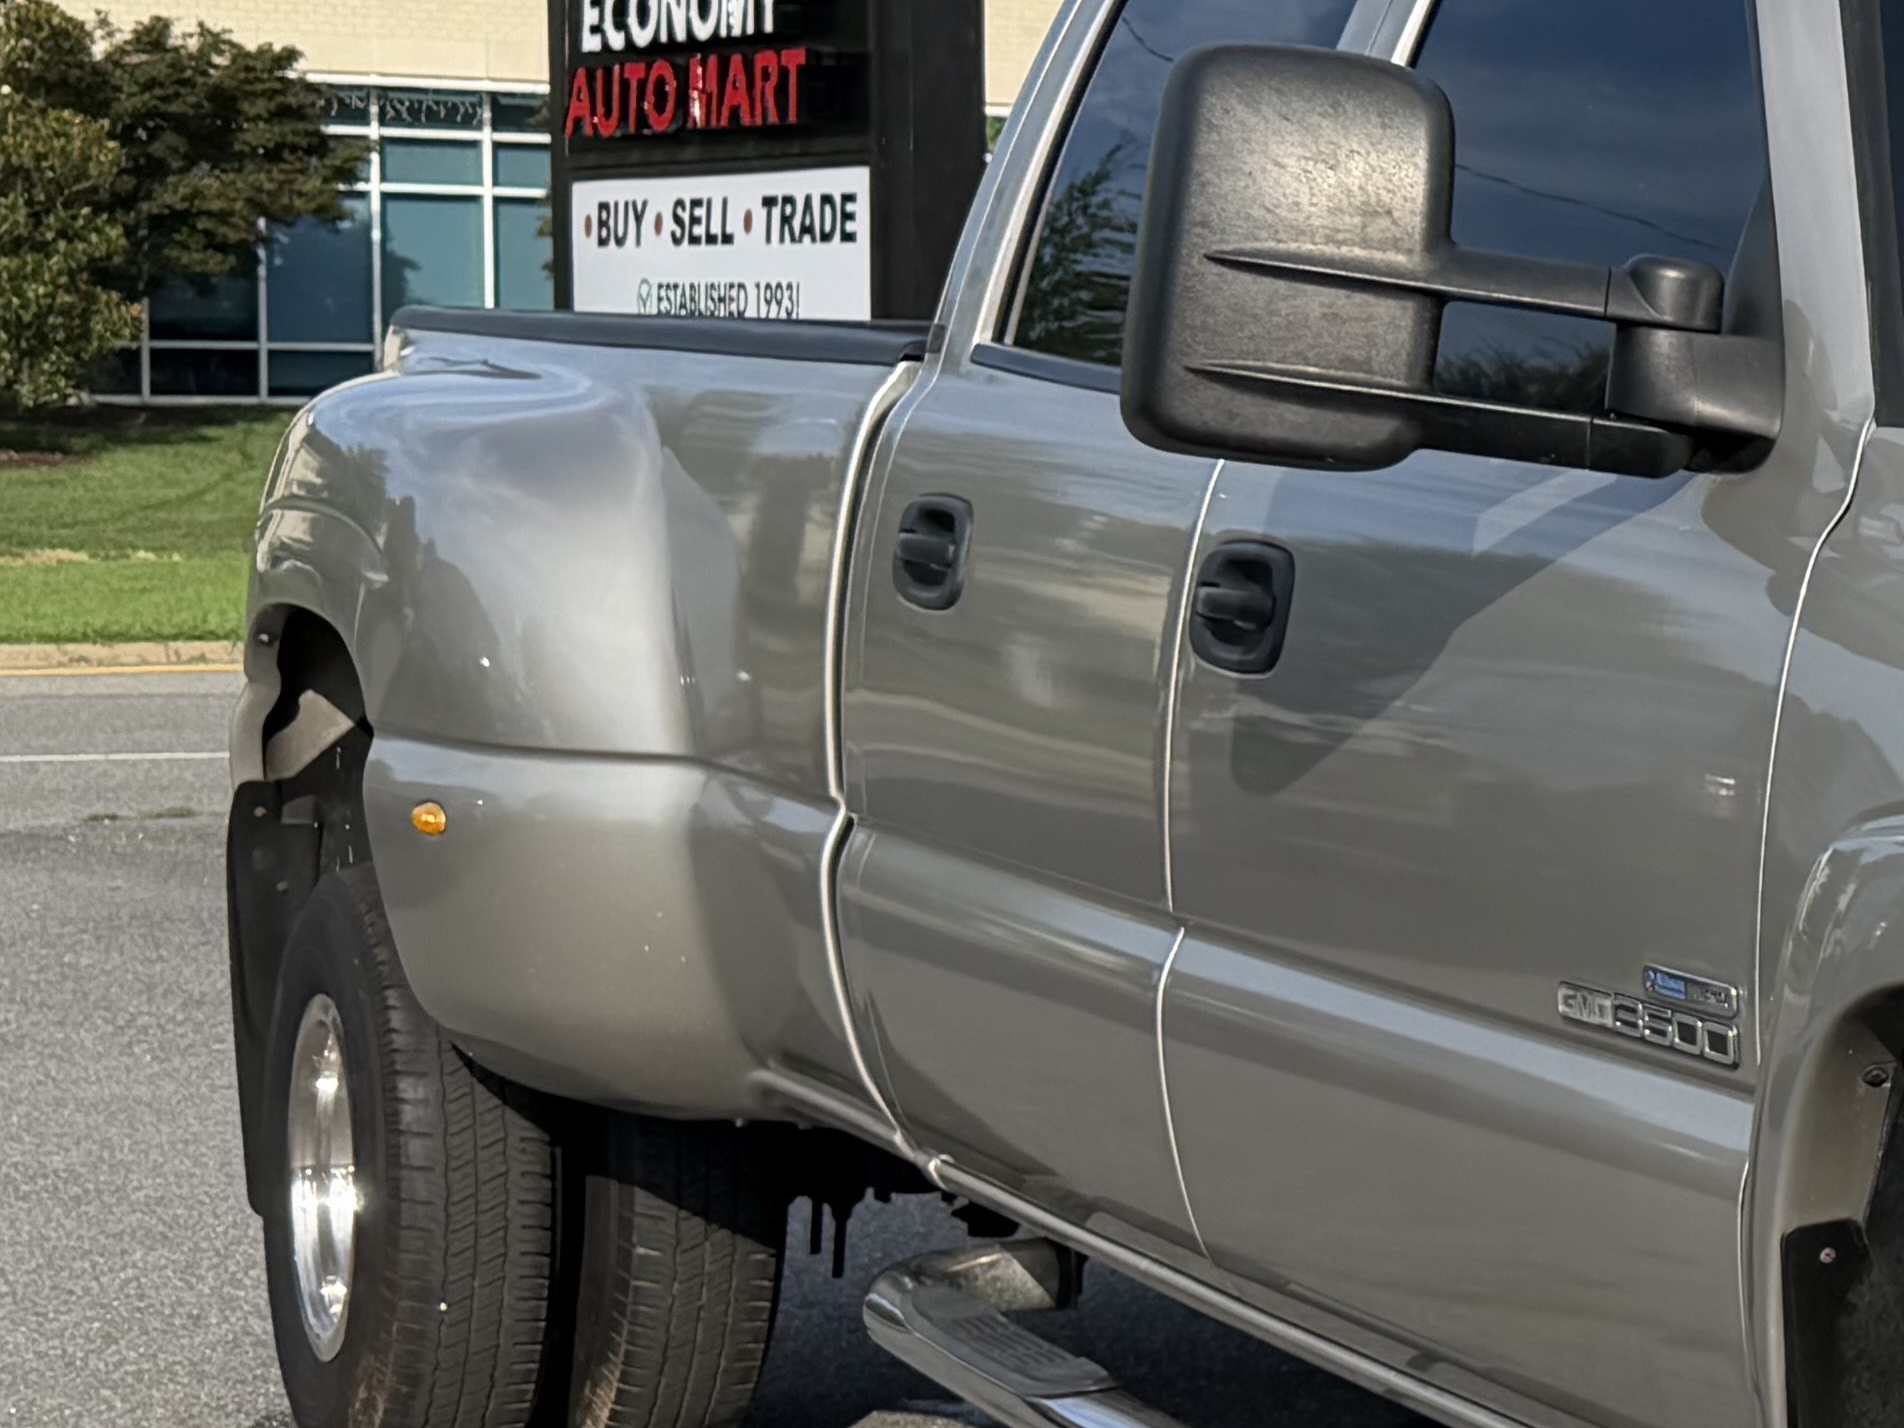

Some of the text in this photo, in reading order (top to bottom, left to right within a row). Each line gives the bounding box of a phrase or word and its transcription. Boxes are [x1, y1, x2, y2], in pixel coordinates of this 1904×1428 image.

[564, 47, 807, 139] AUTO MART
[597, 192, 858, 249] BUY SELL TRADE
[656, 281, 749, 318] ESTABLISHED
